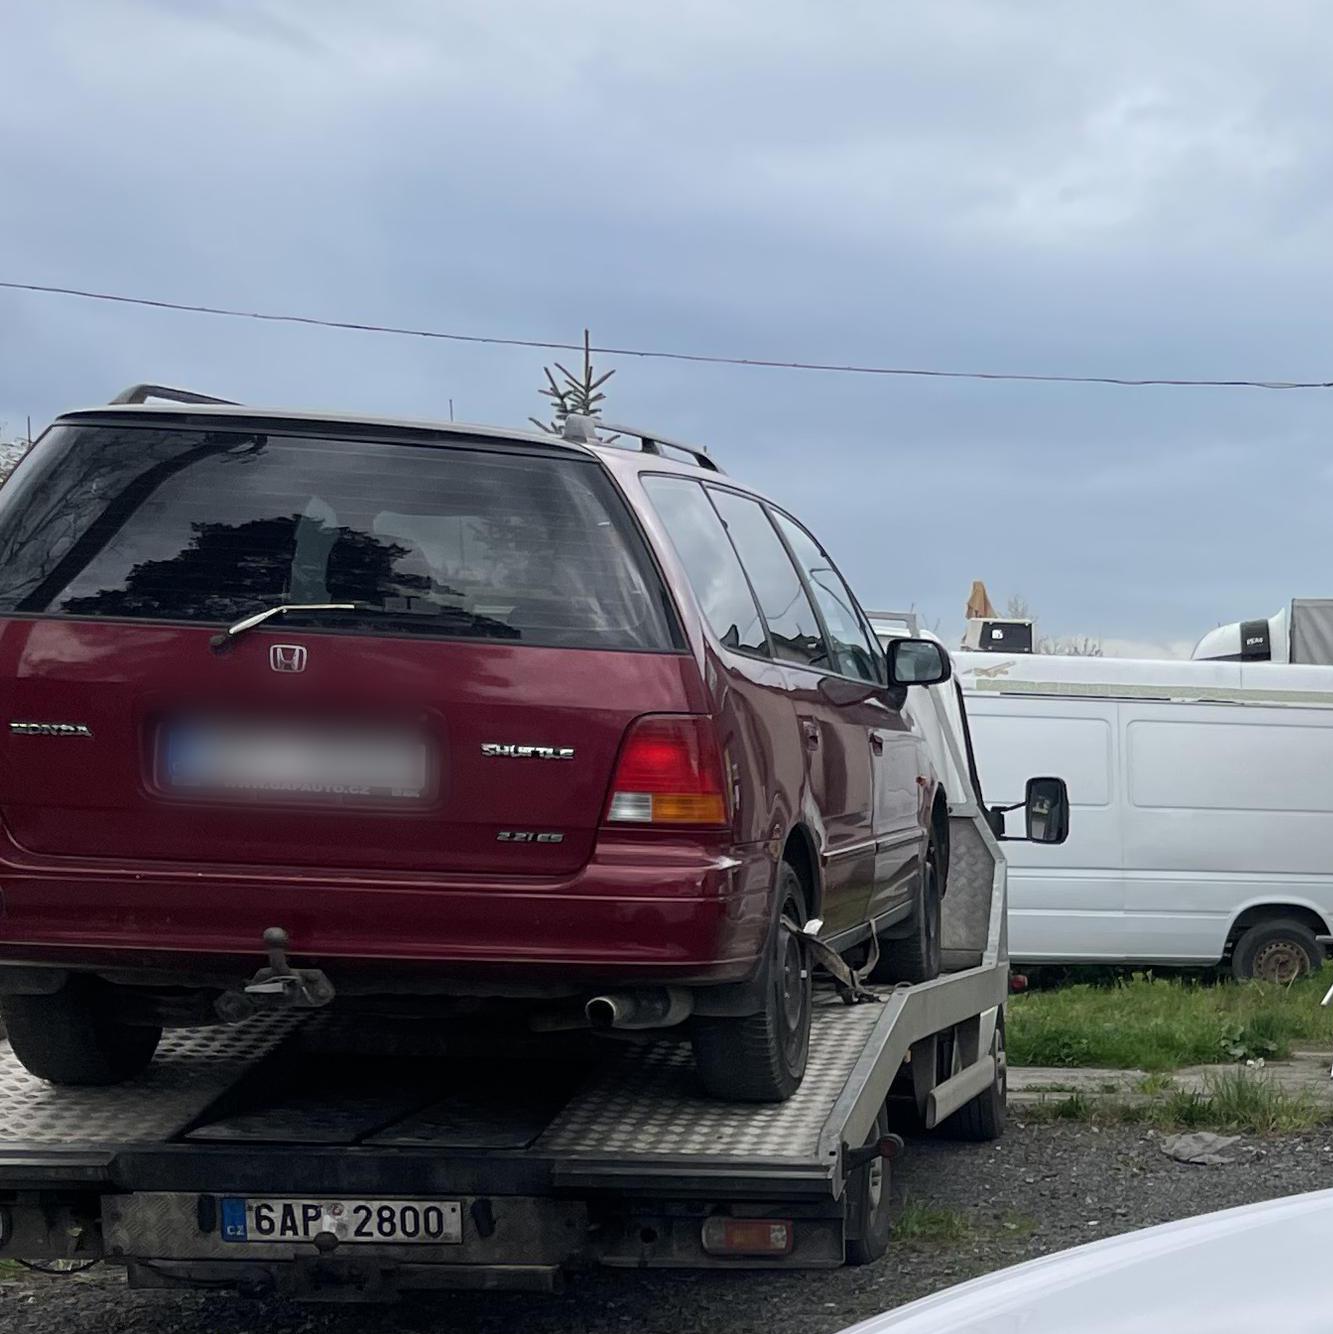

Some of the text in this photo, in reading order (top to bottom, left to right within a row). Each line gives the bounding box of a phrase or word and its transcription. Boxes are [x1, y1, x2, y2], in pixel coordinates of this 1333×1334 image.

[226, 1203, 444, 1238] CZ 6AP 2800
